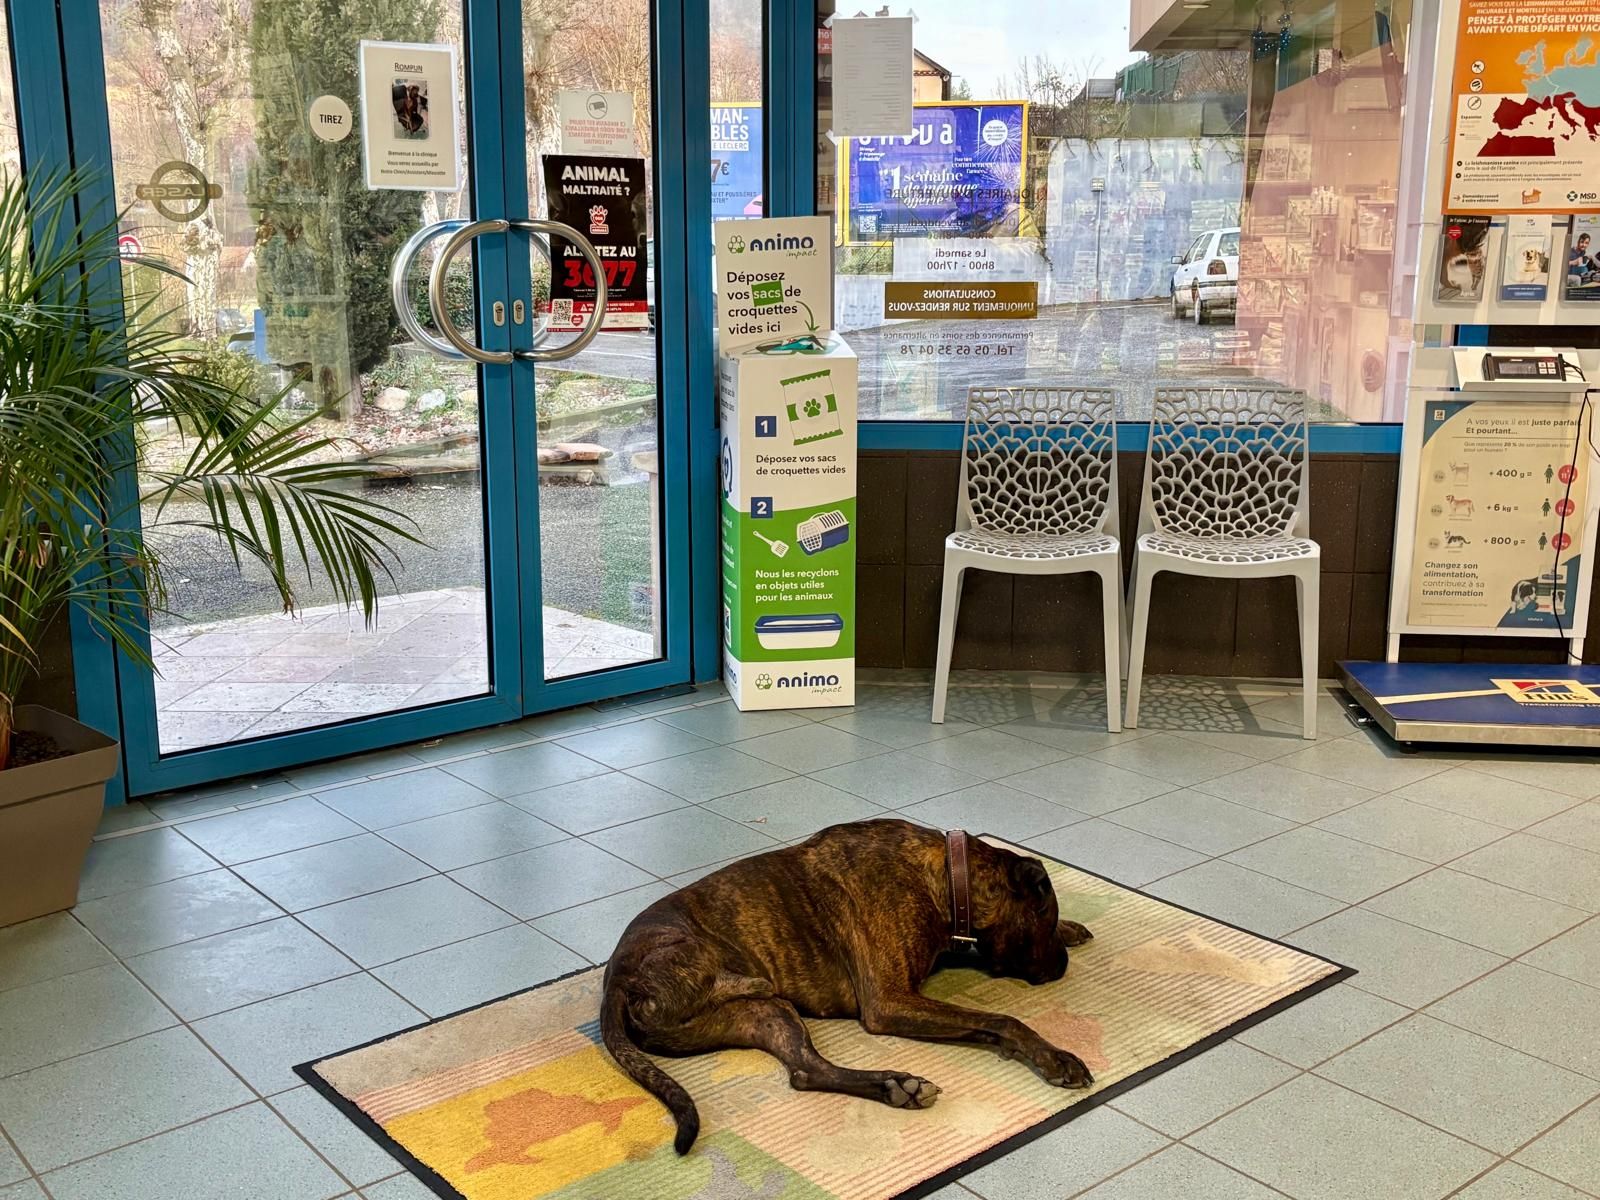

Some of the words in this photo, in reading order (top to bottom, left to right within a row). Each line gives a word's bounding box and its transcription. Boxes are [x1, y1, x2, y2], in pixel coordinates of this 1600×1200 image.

[1468, 16, 1506, 25] PENSEZ
[1506, 14, 1514, 24] À
[1516, 13, 1567, 24] PROTÉGER
[1569, 14, 1600, 23] VOTRE
[1467, 26, 1498, 34] AVANT
[1500, 24, 1530, 33] VOTRE
[1530, 24, 1566, 32] DÉPART
[320, 114, 343, 124] TIREZ
[711, 125, 749, 140] BLES
[561, 165, 630, 182] ANIMAL
[904, 171, 963, 182] semaine
[563, 184, 622, 196] MALTRAITÉ
[624, 187, 630, 196] ?
[750, 233, 814, 251] animo
[563, 245, 617, 257] ALTEZ
[620, 246, 636, 257] AU
[786, 249, 818, 258] impact
[726, 271, 785, 284] Déposez
[727, 290, 750, 300] vos
[753, 289, 781, 300] sacs
[784, 285, 801, 298] de
[728, 304, 798, 320] croquettes
[728, 323, 762, 336] vides
[766, 322, 781, 333] ici
[761, 420, 768, 434] 1
[756, 454, 797, 465] Déposez
[756, 467, 768, 475] de
[770, 467, 820, 476] croquettes
[822, 465, 846, 474] vides
[1496, 469, 1518, 478] 400
[757, 501, 767, 514] 2
[797, 568, 839, 580] recyclons
[1424, 571, 1478, 579] alimentation,
[770, 582, 798, 592] objets
[801, 580, 825, 589] utiles
[756, 594, 777, 603] pour
[777, 672, 839, 688] animo
